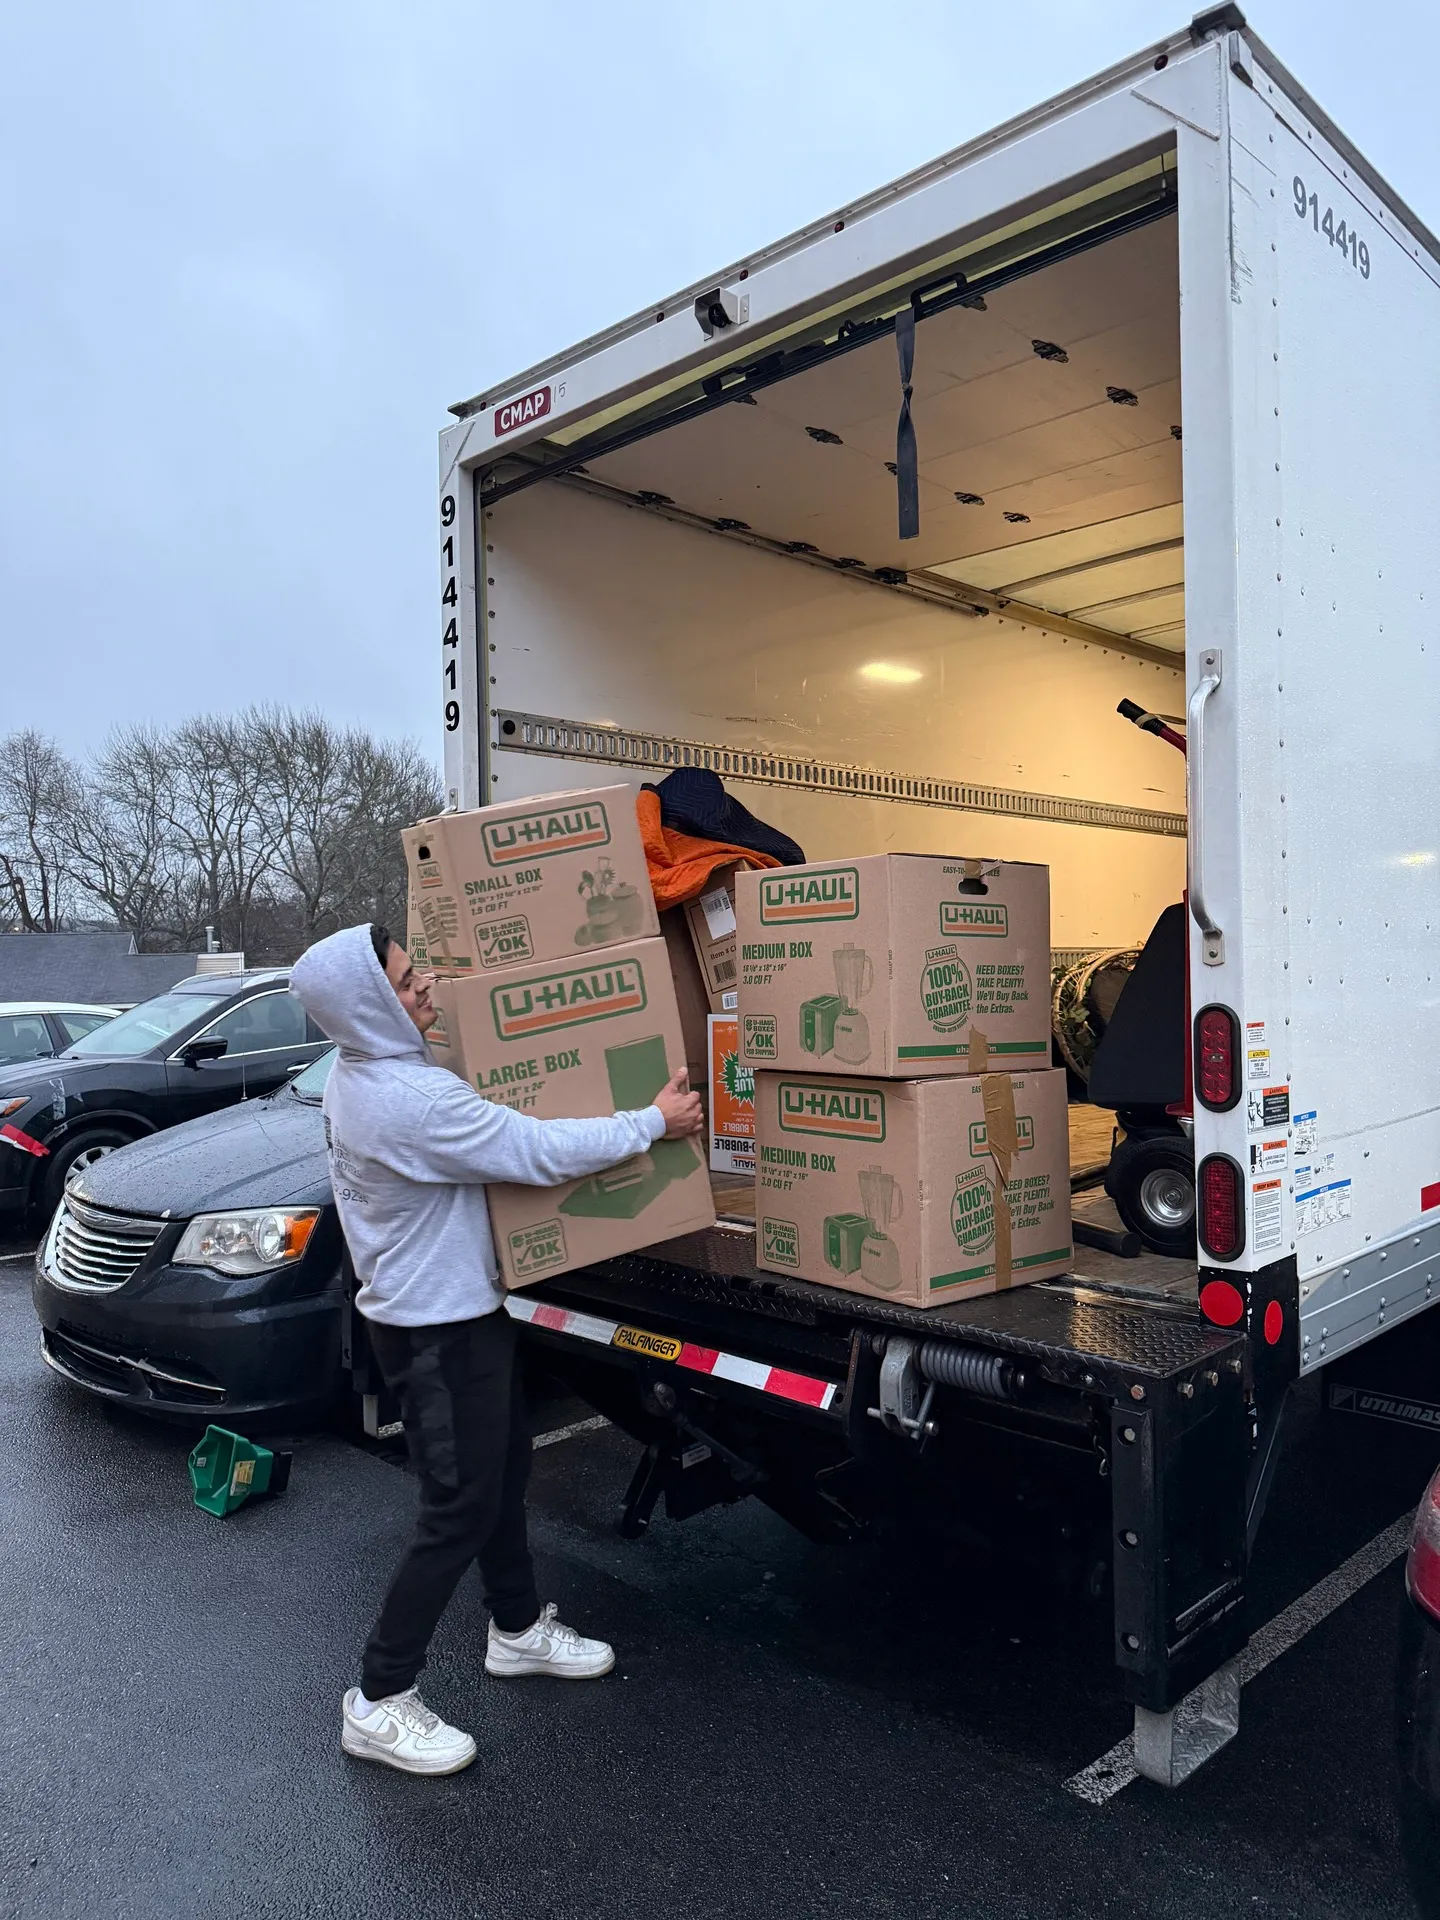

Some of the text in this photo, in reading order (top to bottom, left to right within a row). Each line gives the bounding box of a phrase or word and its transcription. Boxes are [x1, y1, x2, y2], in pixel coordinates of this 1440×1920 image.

[1293, 175, 1370, 280] 914419
[500, 392, 545, 430] CMAP
[440, 495, 460, 732] 914419
[490, 810, 601, 848] U-HAUL
[464, 868, 543, 896] SMALL BOX
[765, 876, 852, 906] U-HAUL
[471, 901, 509, 916] 1.5 CU FT
[944, 907, 1004, 925] U-HAUL
[497, 934, 528, 952] OK
[742, 943, 786, 960] MEDIUM
[789, 941, 813, 959] BOX
[710, 950, 725, 960] Item
[927, 946, 956, 960] U-HAUL
[926, 962, 964, 990] 100%
[976, 964, 1025, 975] NEED BOXES?
[743, 974, 773, 985] 3.0 CU FT
[976, 977, 1025, 988] TAKE PLENTY!
[502, 970, 635, 1018] U-HAUL
[925, 983, 970, 1008] BUY-BACK
[976, 990, 1029, 1003] We'll Buy Back
[927, 999, 971, 1022] GUARANTEE
[976, 1003, 1015, 1014] the Extras.
[755, 1034, 775, 1048] OK
[476, 1048, 583, 1090] LARGE BOX
[734, 1066, 754, 1078] ACK
[734, 1077, 755, 1092] LUE
[523, 1095, 538, 1108] FT
[785, 1090, 878, 1122] U-HAUL
[722, 1122, 750, 1133] BUBBLE
[732, 1158, 756, 1169] HAUL
[760, 1145, 836, 1173] MEDIUM BOX
[761, 1176, 793, 1191] 3.0 CU FT
[957, 1168, 984, 1184] U-HAUL
[1024, 1174, 1051, 1188] BOXES?
[956, 1182, 992, 1215] 100%
[1004, 1187, 1051, 1204] TAKE PLENTY!
[1023, 1204, 1037, 1216] Buy
[1038, 1200, 1055, 1212] Back
[1017, 1217, 1042, 1229] Extras.
[773, 1230, 797, 1240] BOXES
[957, 1220, 995, 1247] GUARANTE
[531, 1239, 562, 1259] OK
[775, 1238, 796, 1256] OK
[617, 1329, 677, 1357] PALFINGER
